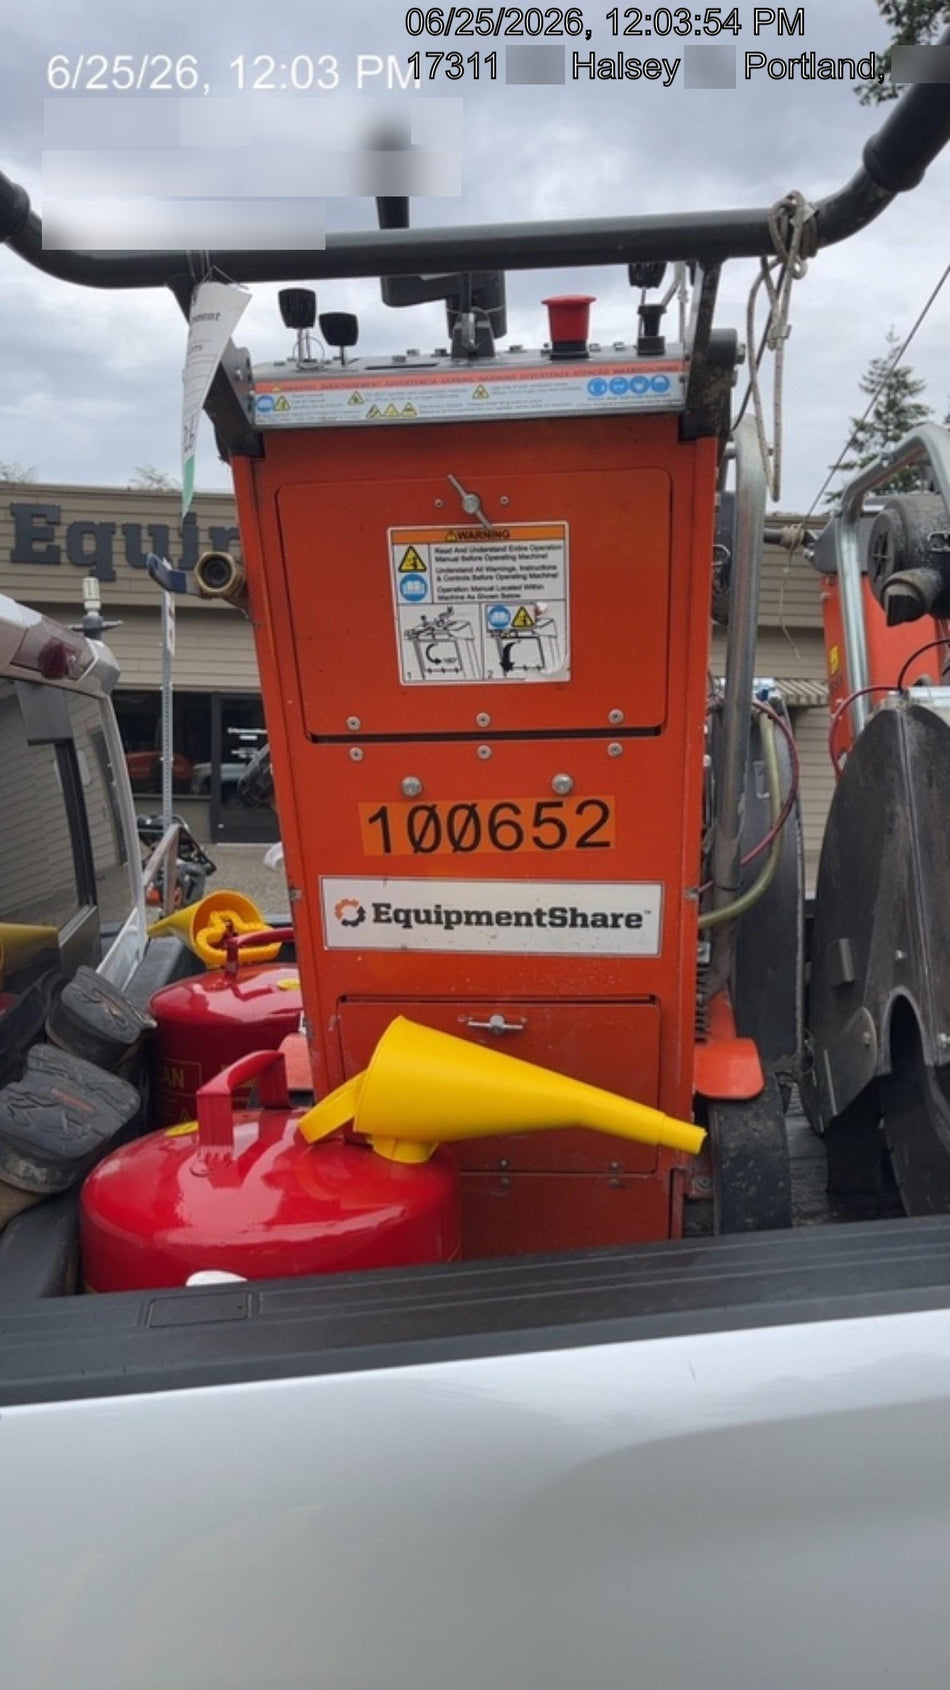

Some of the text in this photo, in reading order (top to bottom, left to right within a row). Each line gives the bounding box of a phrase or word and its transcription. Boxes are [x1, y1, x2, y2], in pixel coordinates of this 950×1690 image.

[458, 529, 510, 541] WARNING
[469, 544, 507, 553] Understand
[529, 543, 562, 552] Operation
[435, 555, 458, 563] Manual
[461, 554, 483, 562] Before
[484, 553, 517, 562] Operating
[435, 566, 473, 574] Understand
[443, 574, 470, 582] Controls
[496, 573, 528, 582] Operating
[437, 586, 470, 594] Operation
[496, 584, 522, 592] Located
[372, 902, 643, 929] EquipmentShare
